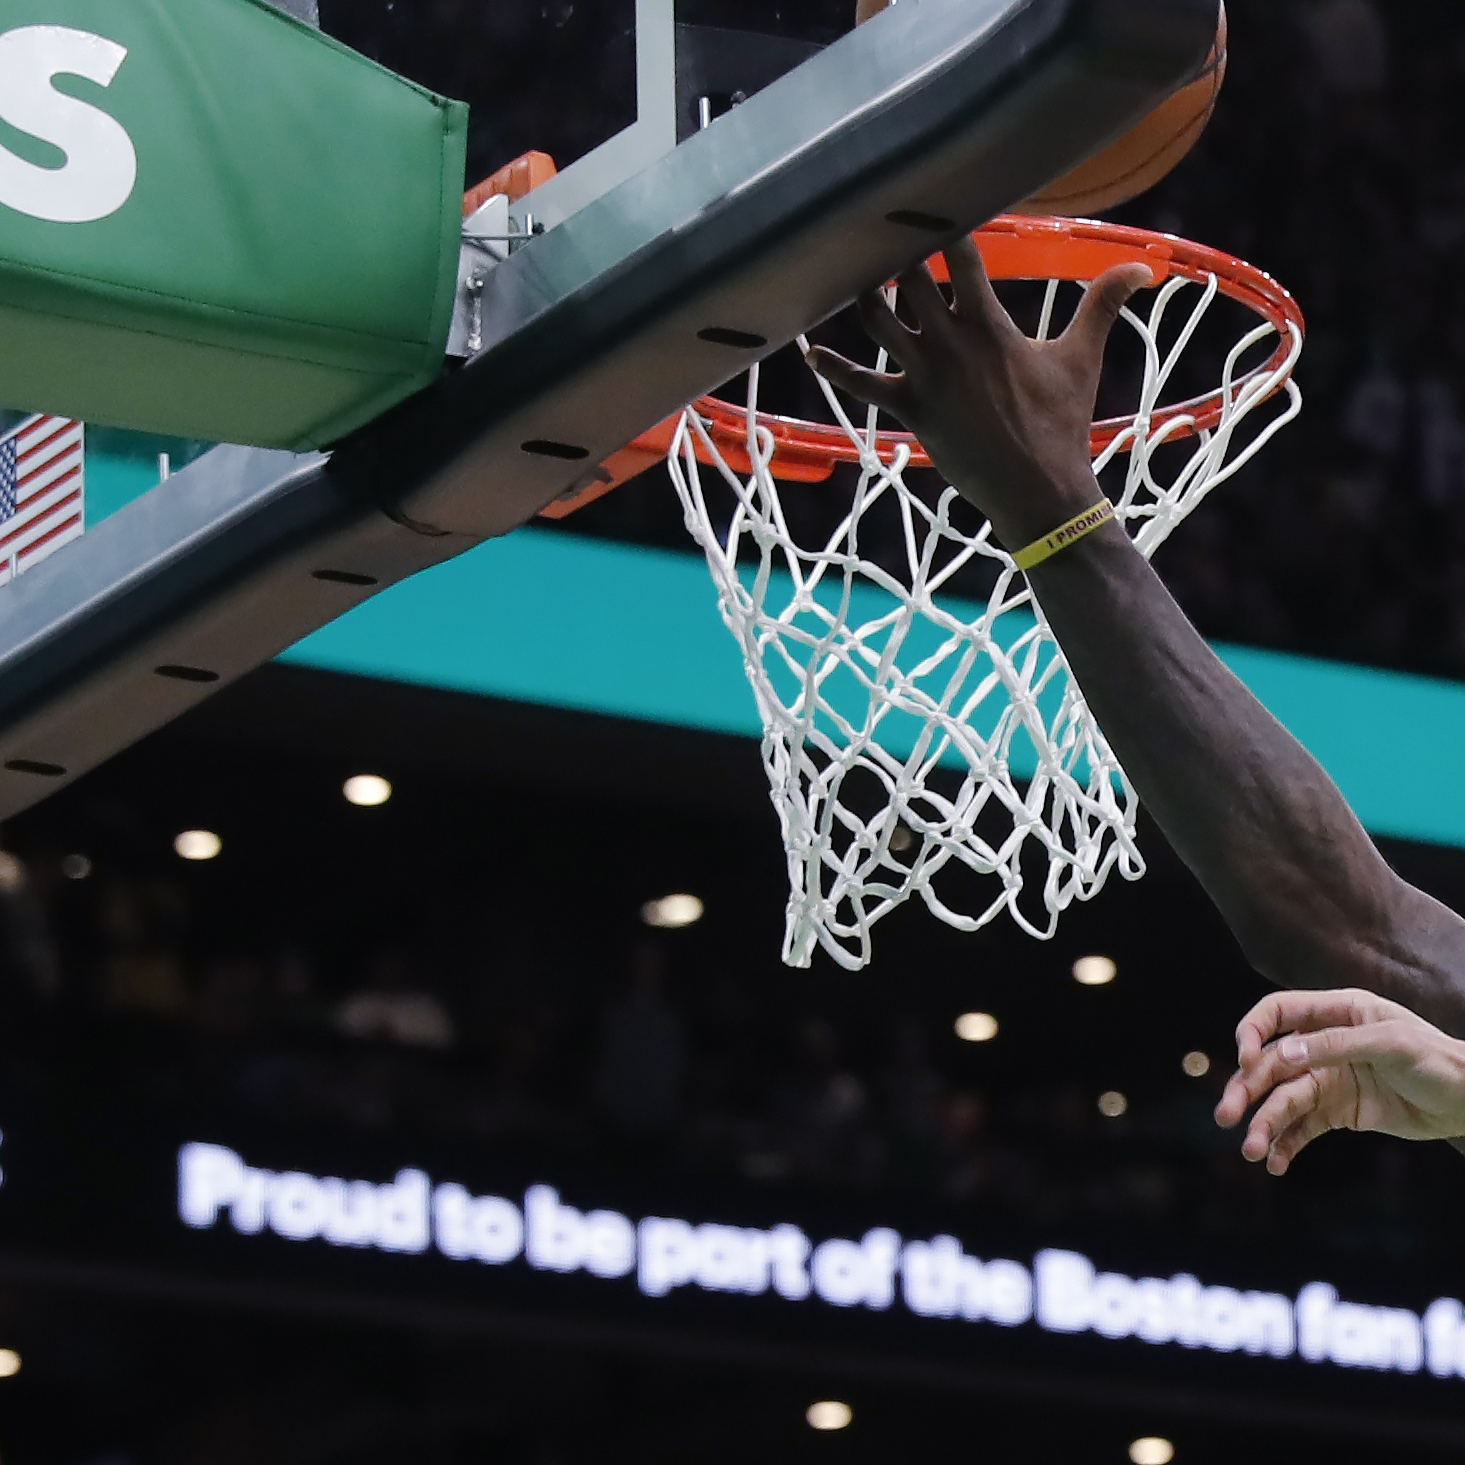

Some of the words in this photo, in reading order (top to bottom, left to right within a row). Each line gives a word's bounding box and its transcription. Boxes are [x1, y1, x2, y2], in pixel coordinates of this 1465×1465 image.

[177, 1140, 431, 1254] Proud
[432, 1181, 524, 1264] to
[524, 1185, 636, 1278] be
[637, 1214, 812, 1299] part
[811, 1226, 903, 1311] of
[902, 1231, 1033, 1327] the
[1033, 1246, 1295, 1360] Boston
[1296, 1281, 1424, 1374] fan
